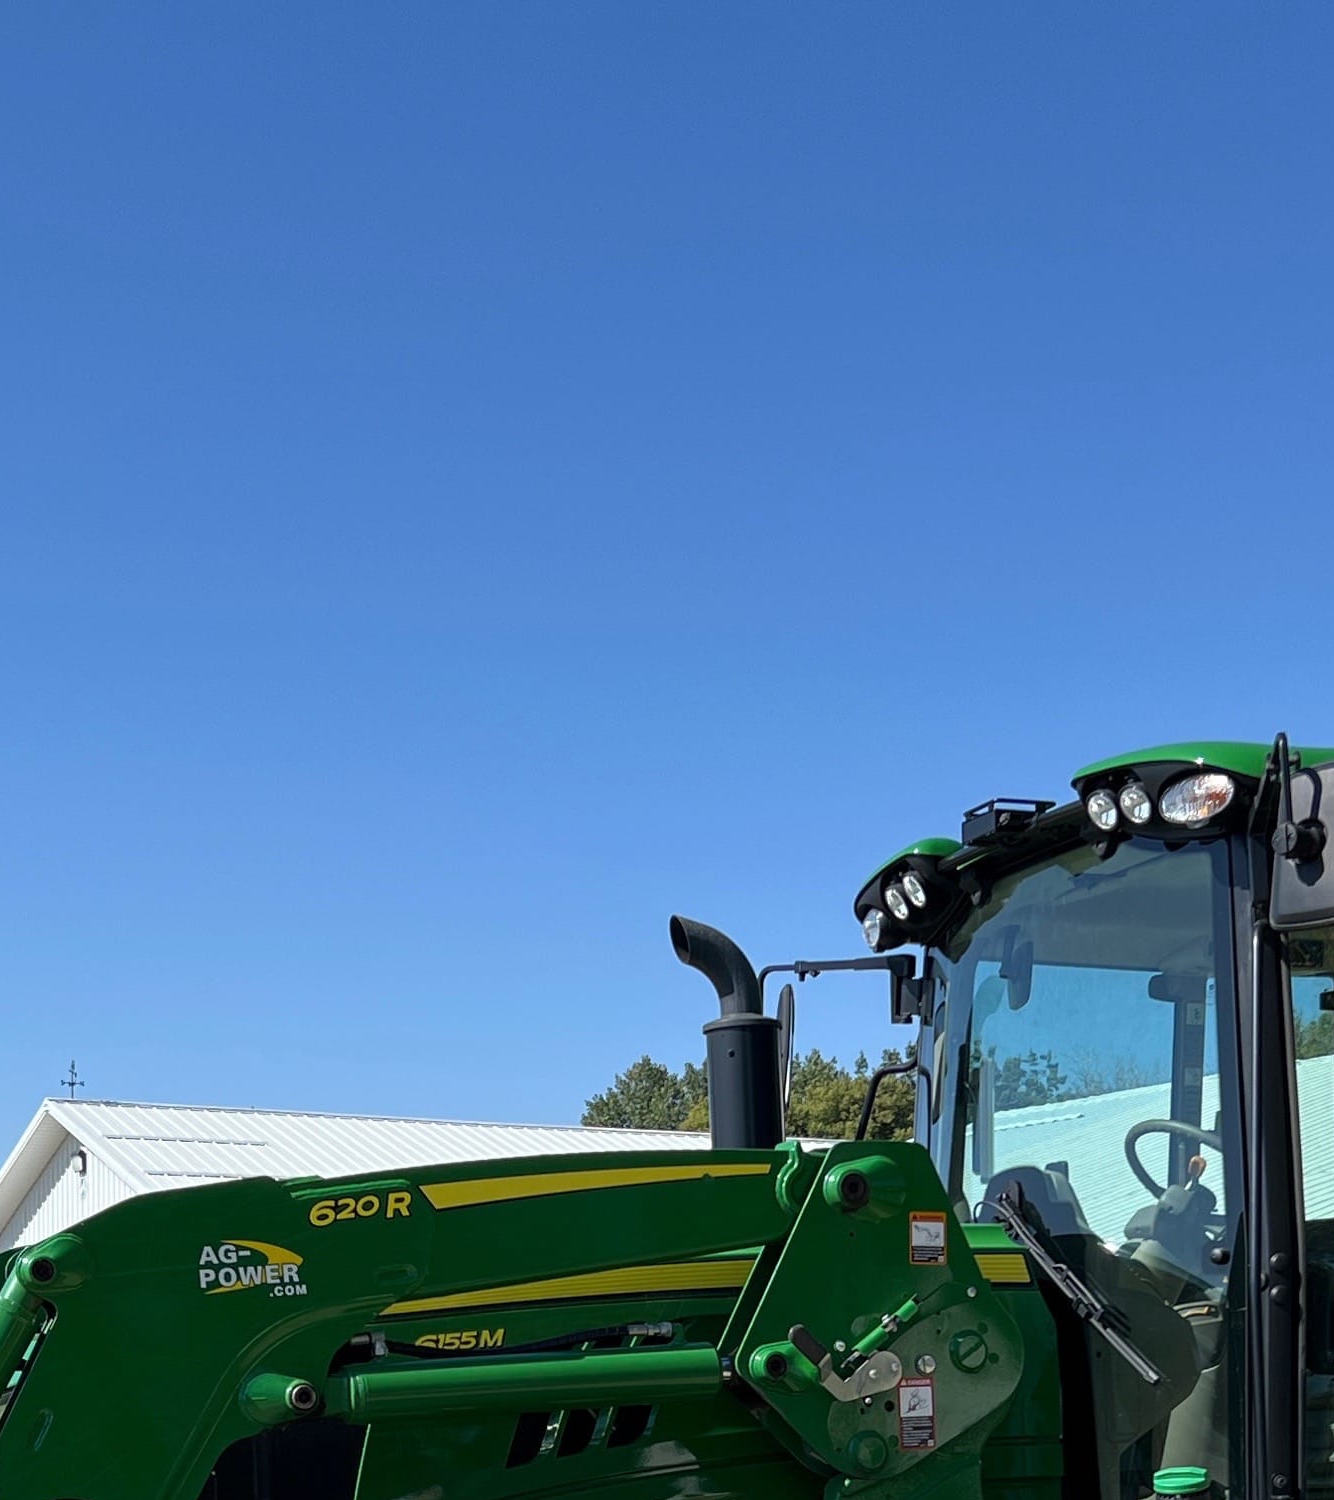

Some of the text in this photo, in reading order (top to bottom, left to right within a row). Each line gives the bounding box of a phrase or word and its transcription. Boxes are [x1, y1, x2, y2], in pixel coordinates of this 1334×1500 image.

[199, 1244, 251, 1265] AG-
[199, 1263, 300, 1289] POWER
[269, 1284, 308, 1298] .COM
